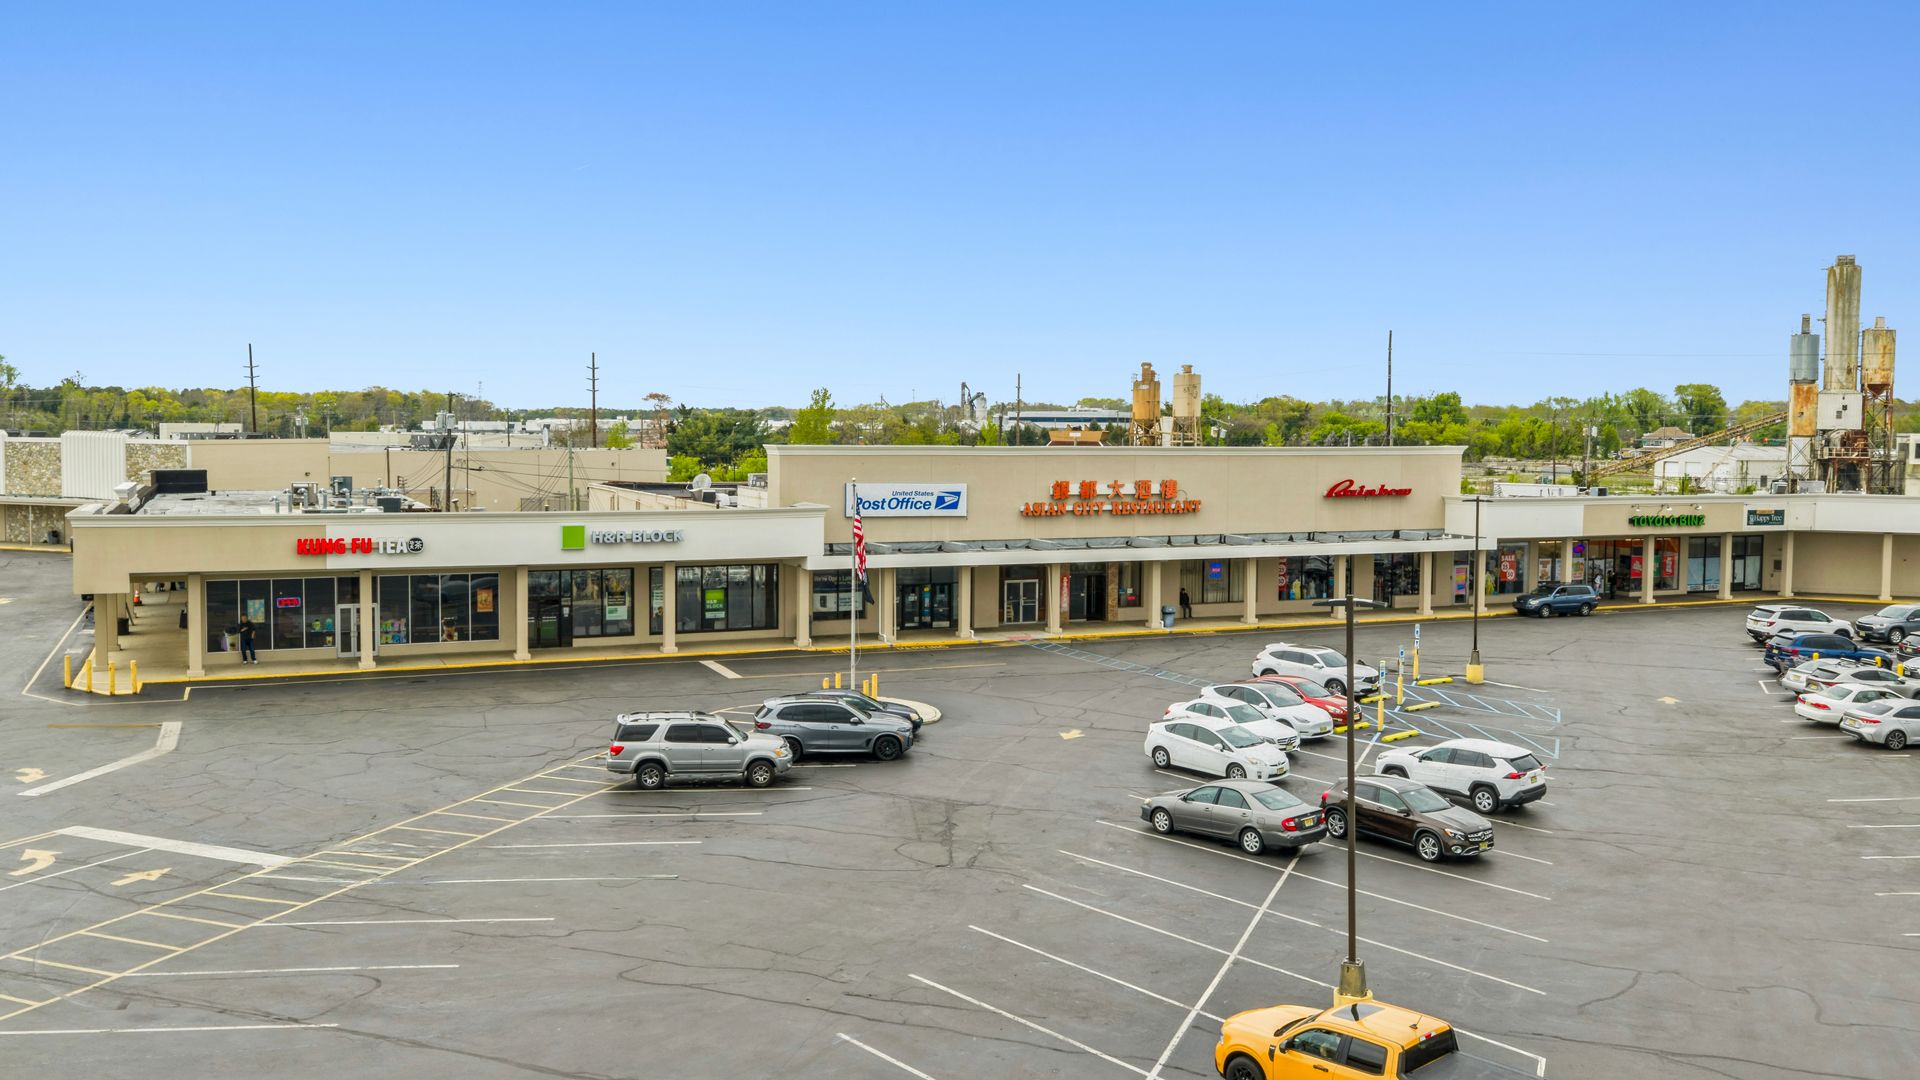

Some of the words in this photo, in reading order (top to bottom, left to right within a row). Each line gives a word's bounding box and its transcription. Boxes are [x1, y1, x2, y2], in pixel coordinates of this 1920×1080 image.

[1326, 479, 1412, 498] Rainbow
[888, 497, 932, 510] Office
[1023, 503, 1067, 516] ASIAN
[1072, 502, 1104, 516] CITY
[1111, 500, 1200, 515] RESTAURANT
[1632, 515, 1677, 527] TOYOLO
[592, 531, 627, 543] H&R
[632, 529, 684, 543] BLOCK
[297, 538, 346, 555] KUNG
[351, 538, 373, 554] FU
[378, 538, 408, 554] TEA
